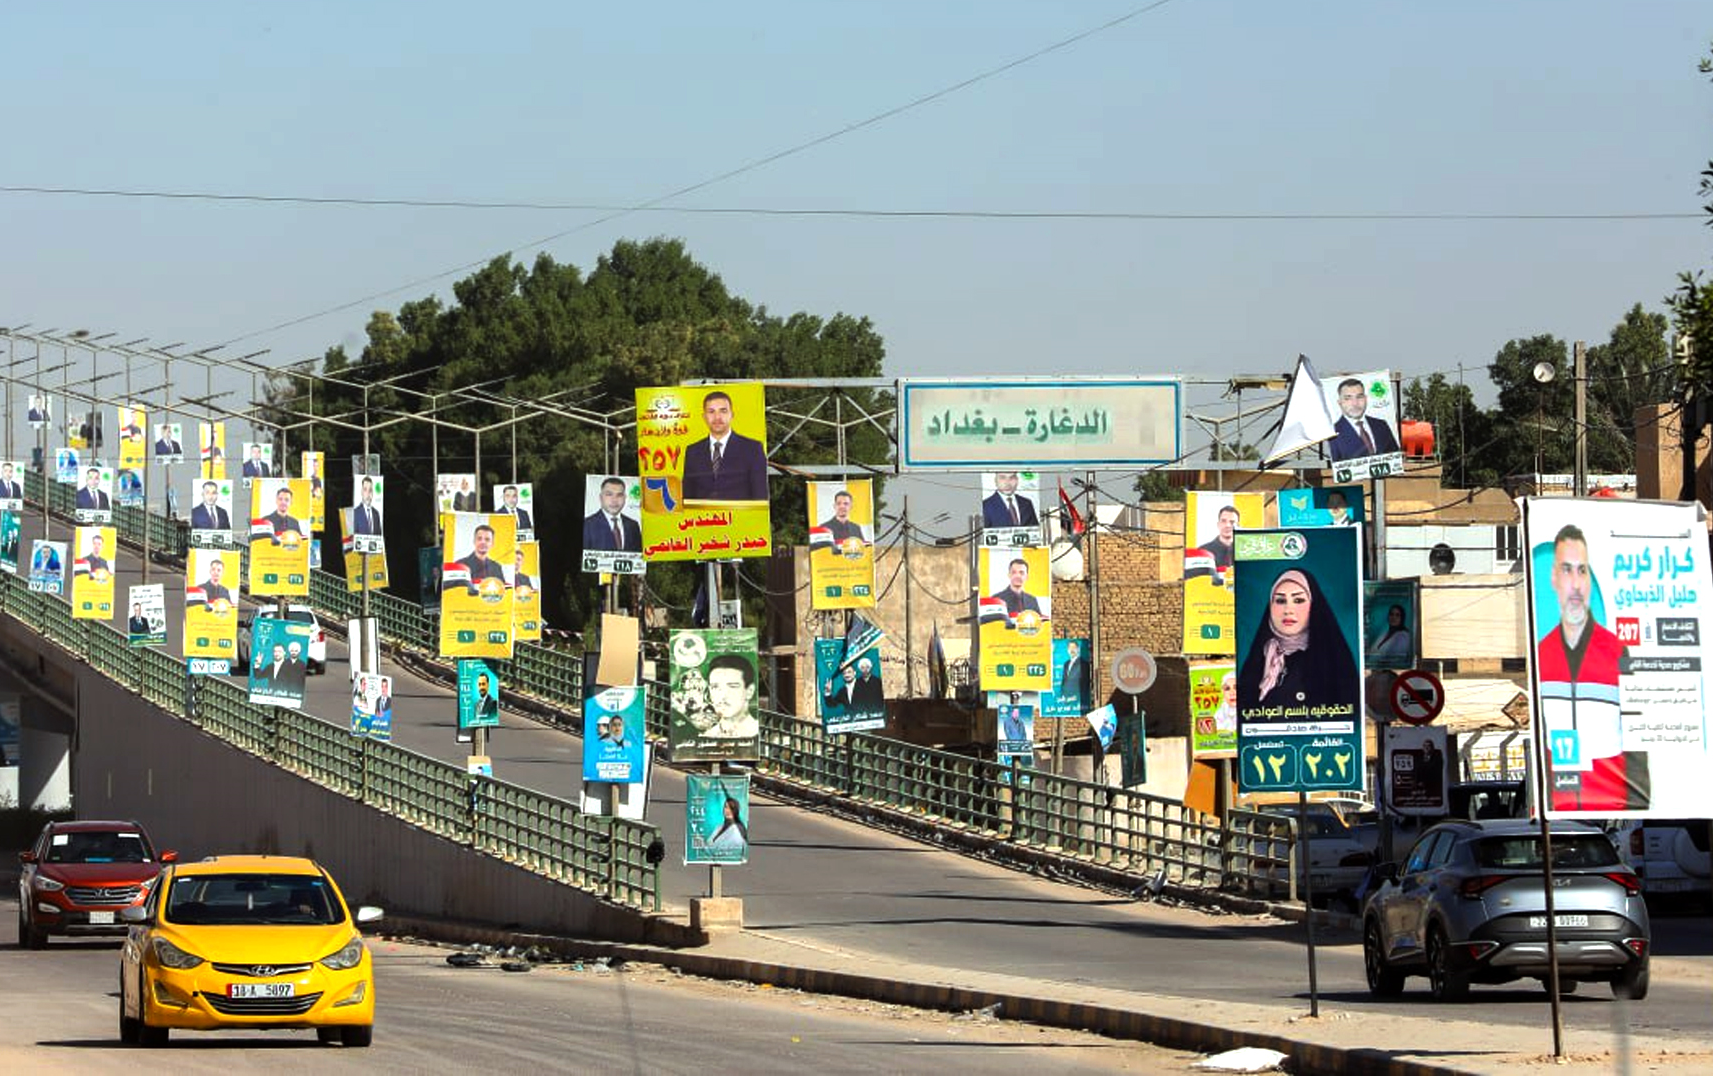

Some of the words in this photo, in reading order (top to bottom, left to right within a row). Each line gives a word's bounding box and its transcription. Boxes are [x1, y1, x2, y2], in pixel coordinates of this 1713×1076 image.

[928, 408, 998, 443] بغداد
[1028, 407, 1107, 442] الدغارة
[638, 445, 681, 471] ٢٥٧
[677, 510, 732, 531] المهندس
[734, 536, 768, 552] حيدر
[1612, 545, 1652, 580] كريم
[1658, 545, 1694, 580] كرار
[1618, 623, 1639, 641] 207
[1194, 695, 1219, 709] ٢٥٧
[1242, 705, 1283, 720] العوادي
[1284, 705, 1309, 719] بلسم
[1556, 738, 1574, 759] 17
[1252, 753, 1286, 783] ١٢
[1305, 752, 1351, 779] ٢٠٢
